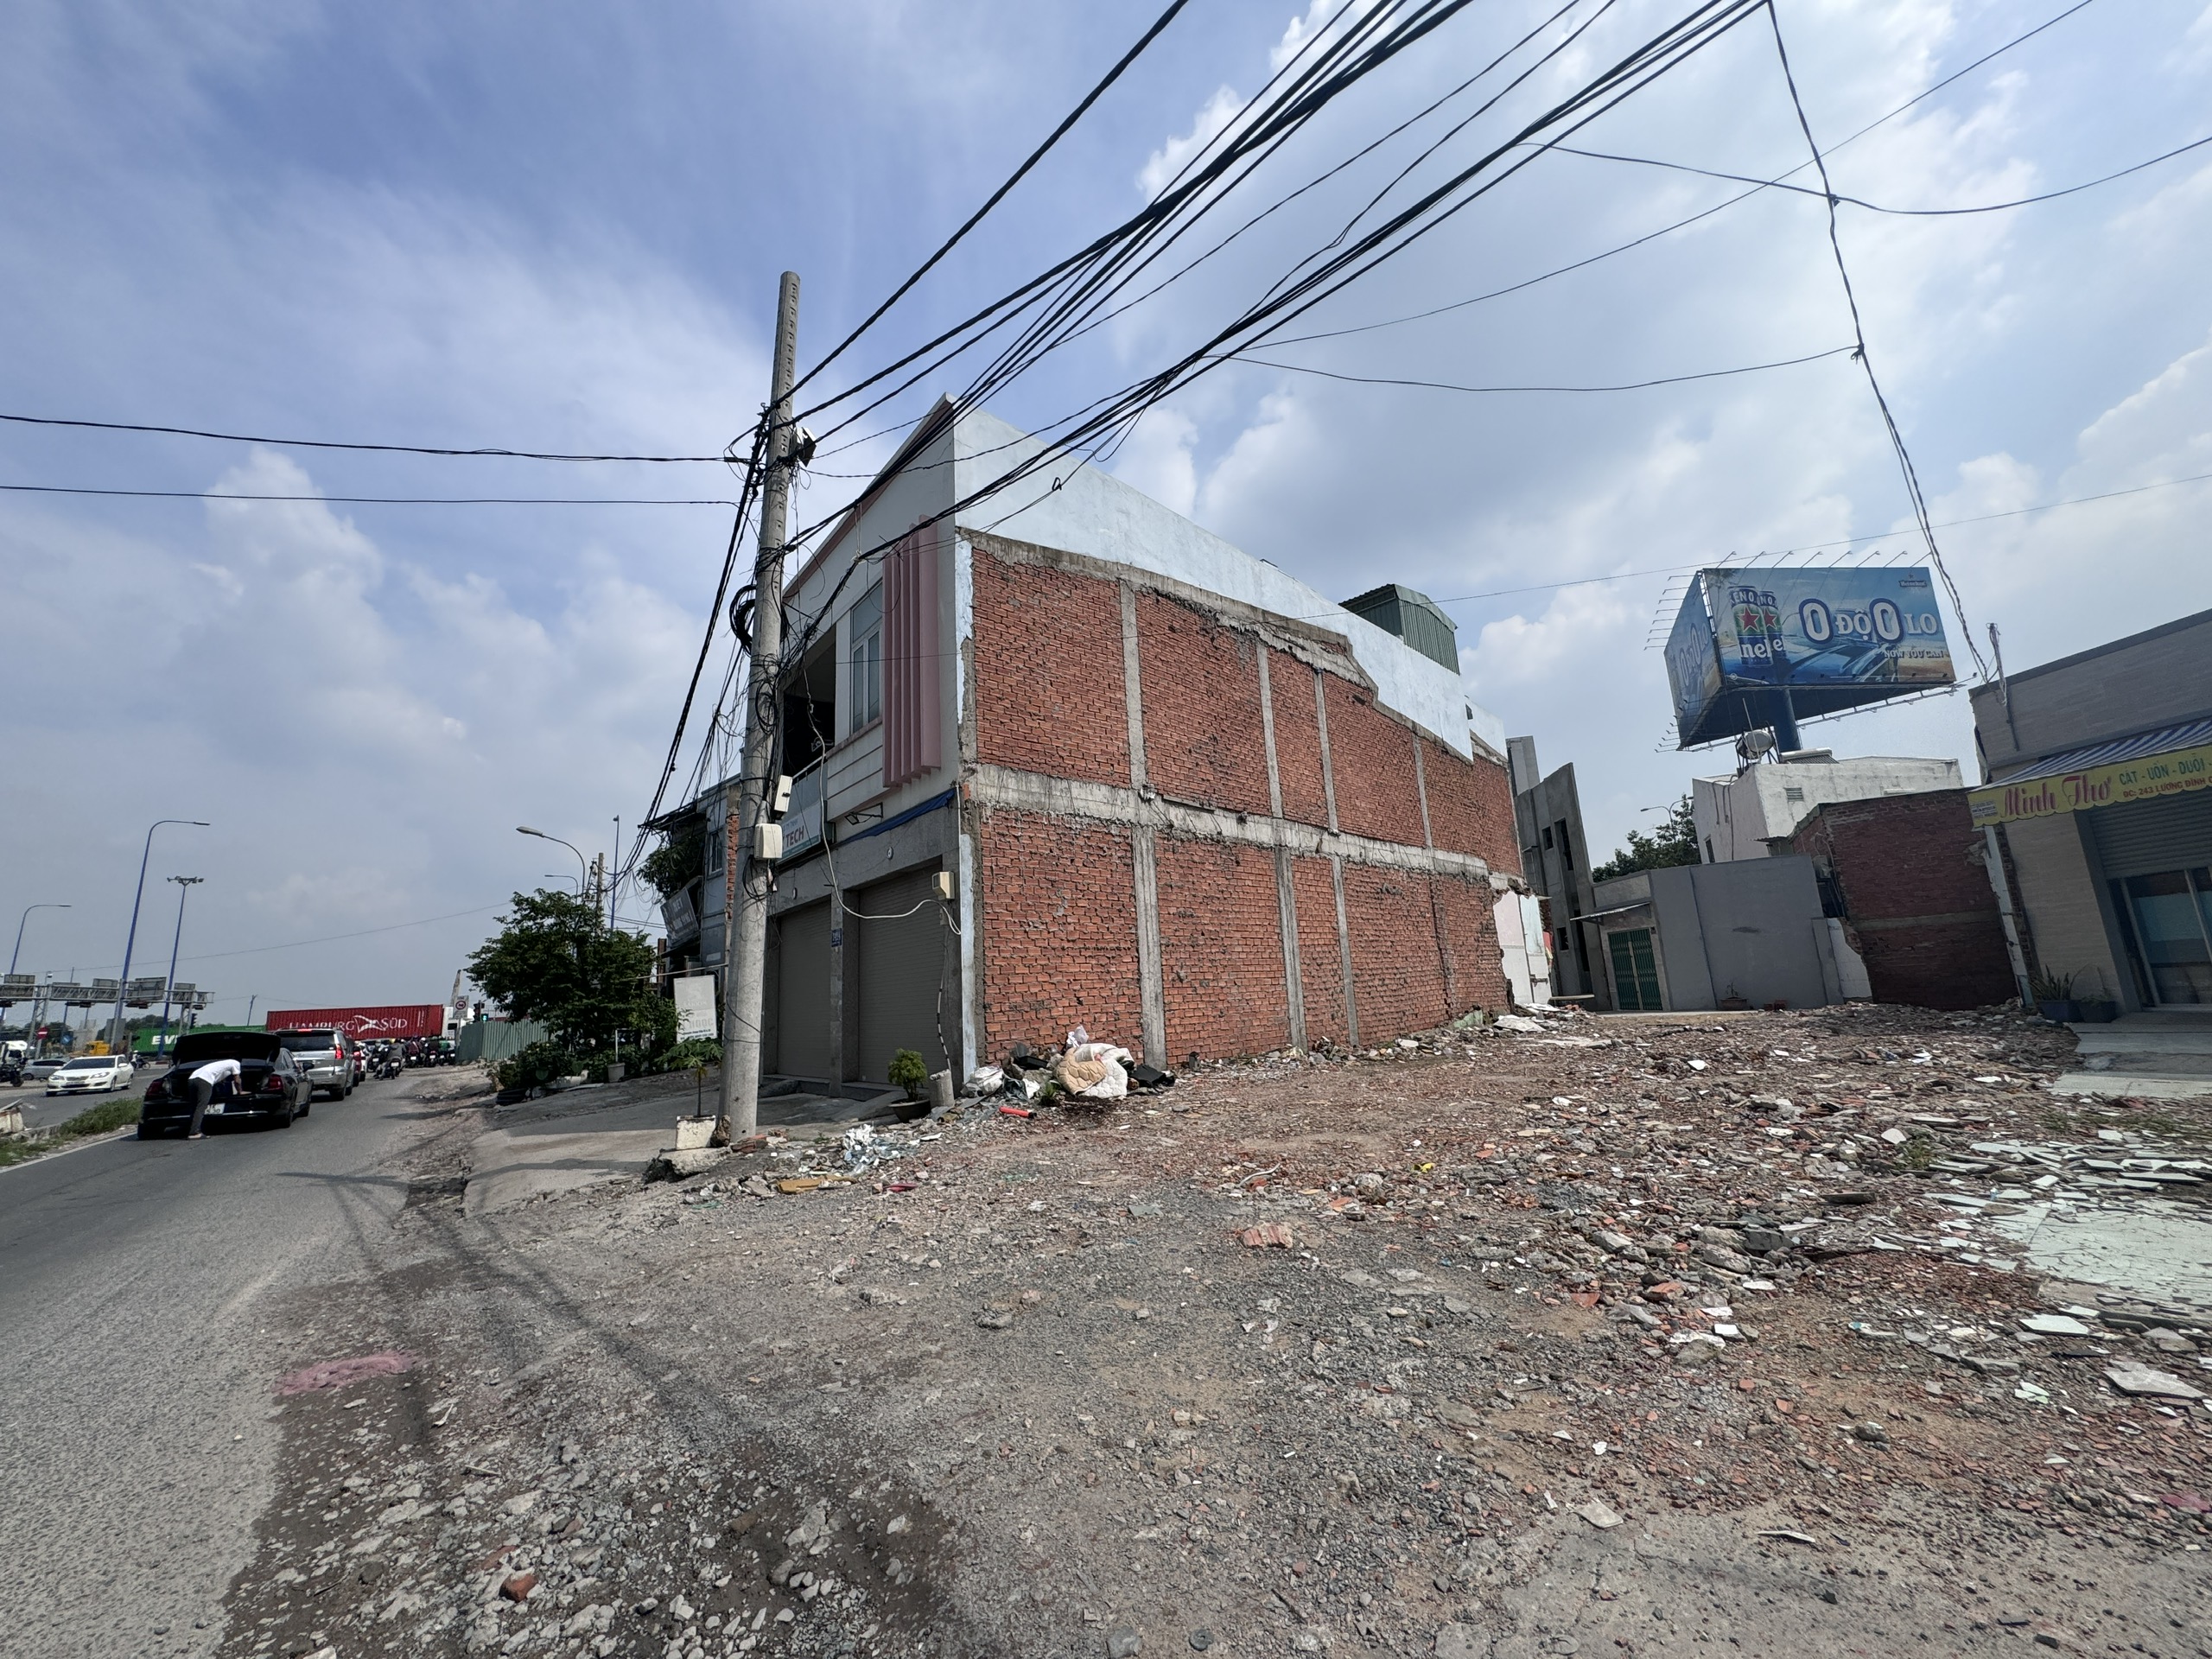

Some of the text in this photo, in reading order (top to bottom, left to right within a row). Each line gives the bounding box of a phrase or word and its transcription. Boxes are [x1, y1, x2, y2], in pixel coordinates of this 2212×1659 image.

[1835, 609, 1872, 640] ĐỘ
[1904, 613, 1937, 634] LO
[2000, 782, 2059, 817] Minh
[2063, 773, 2112, 806] Thơ
[2139, 786, 2154, 795] 243
[785, 825, 804, 848] TECH
[381, 1017, 407, 1029] SÜD
